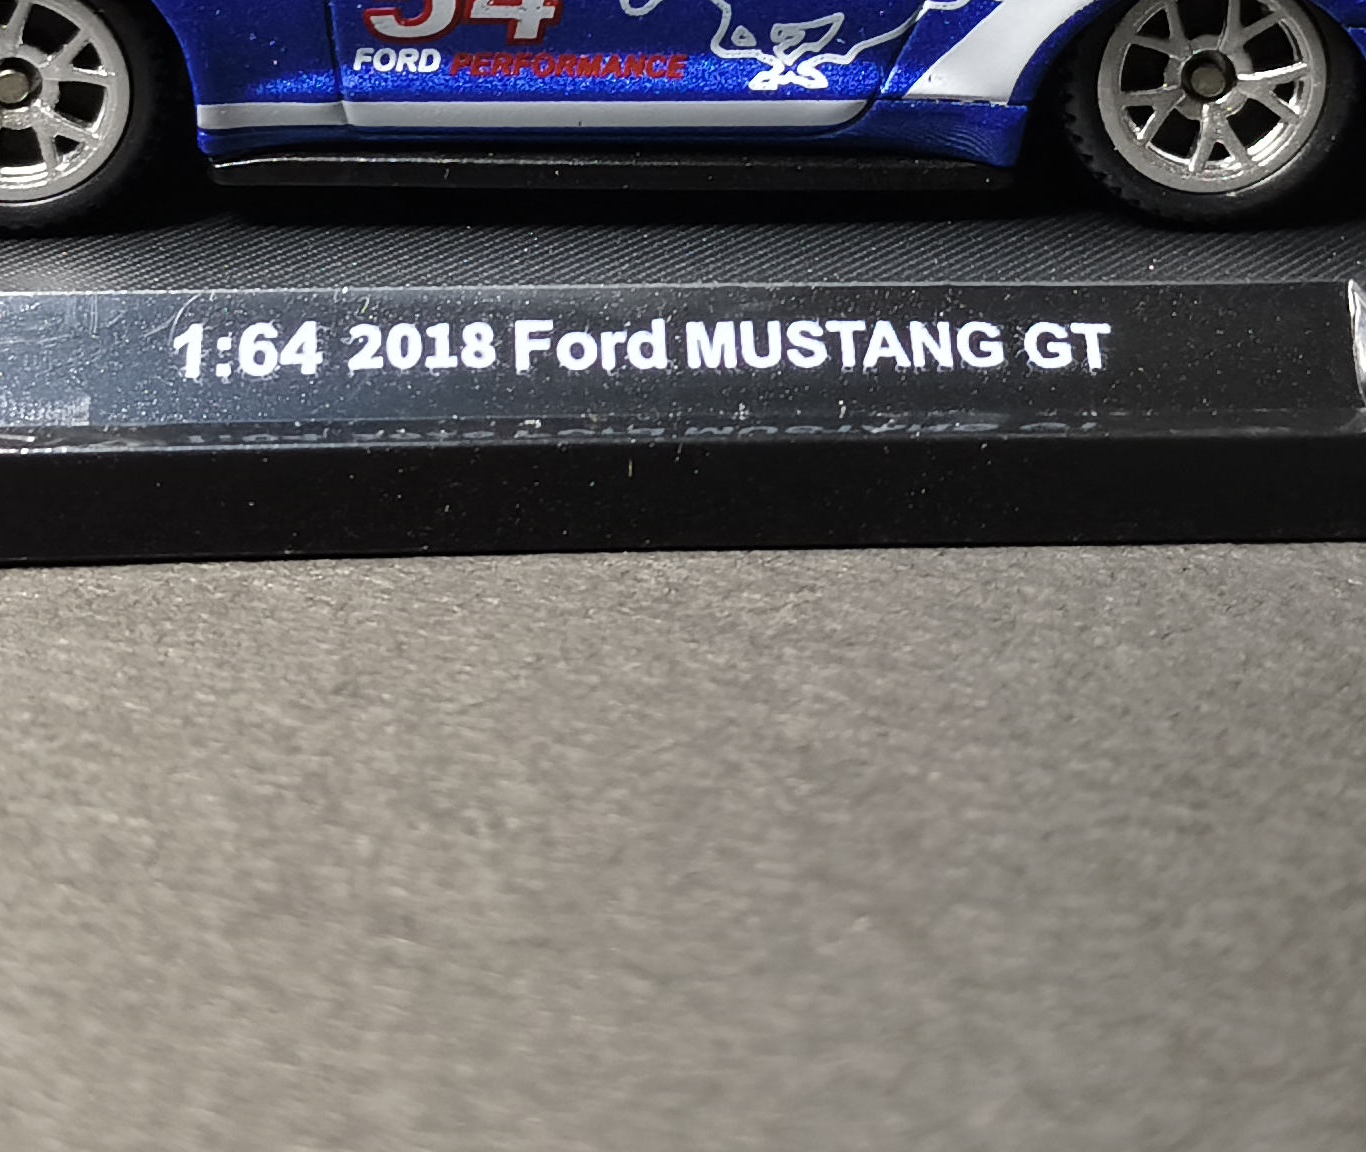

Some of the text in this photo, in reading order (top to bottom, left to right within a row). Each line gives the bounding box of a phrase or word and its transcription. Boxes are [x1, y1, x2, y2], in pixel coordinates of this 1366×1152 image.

[353, 48, 687, 79] FORD PERFORMANCE
[173, 319, 1112, 378] 1:64 2018 Ford MUSTANG GT
